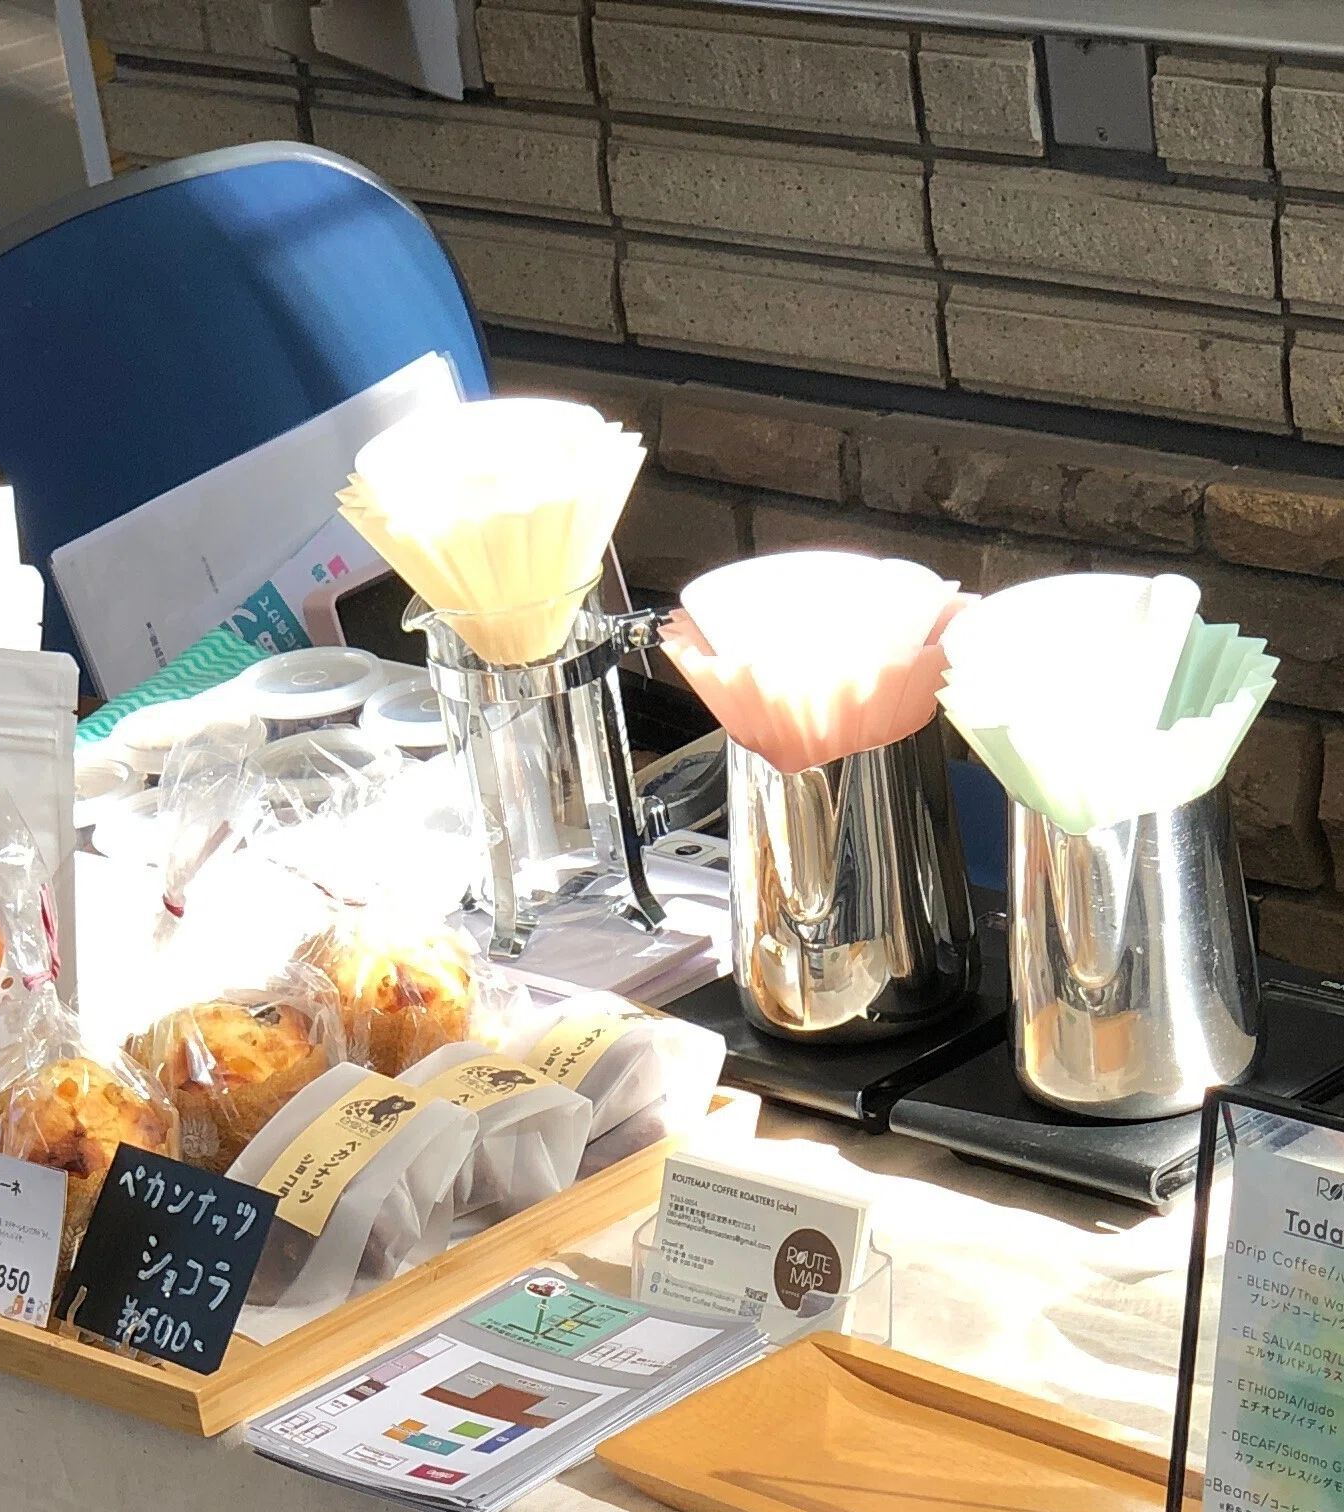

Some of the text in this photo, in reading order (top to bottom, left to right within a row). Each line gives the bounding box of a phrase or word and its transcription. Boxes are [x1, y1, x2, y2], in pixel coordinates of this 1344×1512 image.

[558, 1028, 607, 1084] ペカンナッ
[299, 1141, 361, 1204] ペカンナッツ
[672, 1173, 710, 1190] ROUTEMAP
[712, 1183, 738, 1198] COFFEE
[740, 1191, 775, 1208] ROASTERS
[119, 1164, 257, 1241] ペカンナッツ
[786, 1246, 832, 1275] ROUTE
[1235, 1240, 1266, 1262] Drip
[137, 1236, 232, 1311] ショコラ
[789, 1267, 823, 1290] MAP
[1246, 1275, 1319, 1306] BLEND/The
[1242, 1326, 1258, 1340] EL
[1238, 1379, 1335, 1417] ETHIOPIA/Idido
[1231, 1430, 1327, 1470] DECAF/Sidamo
